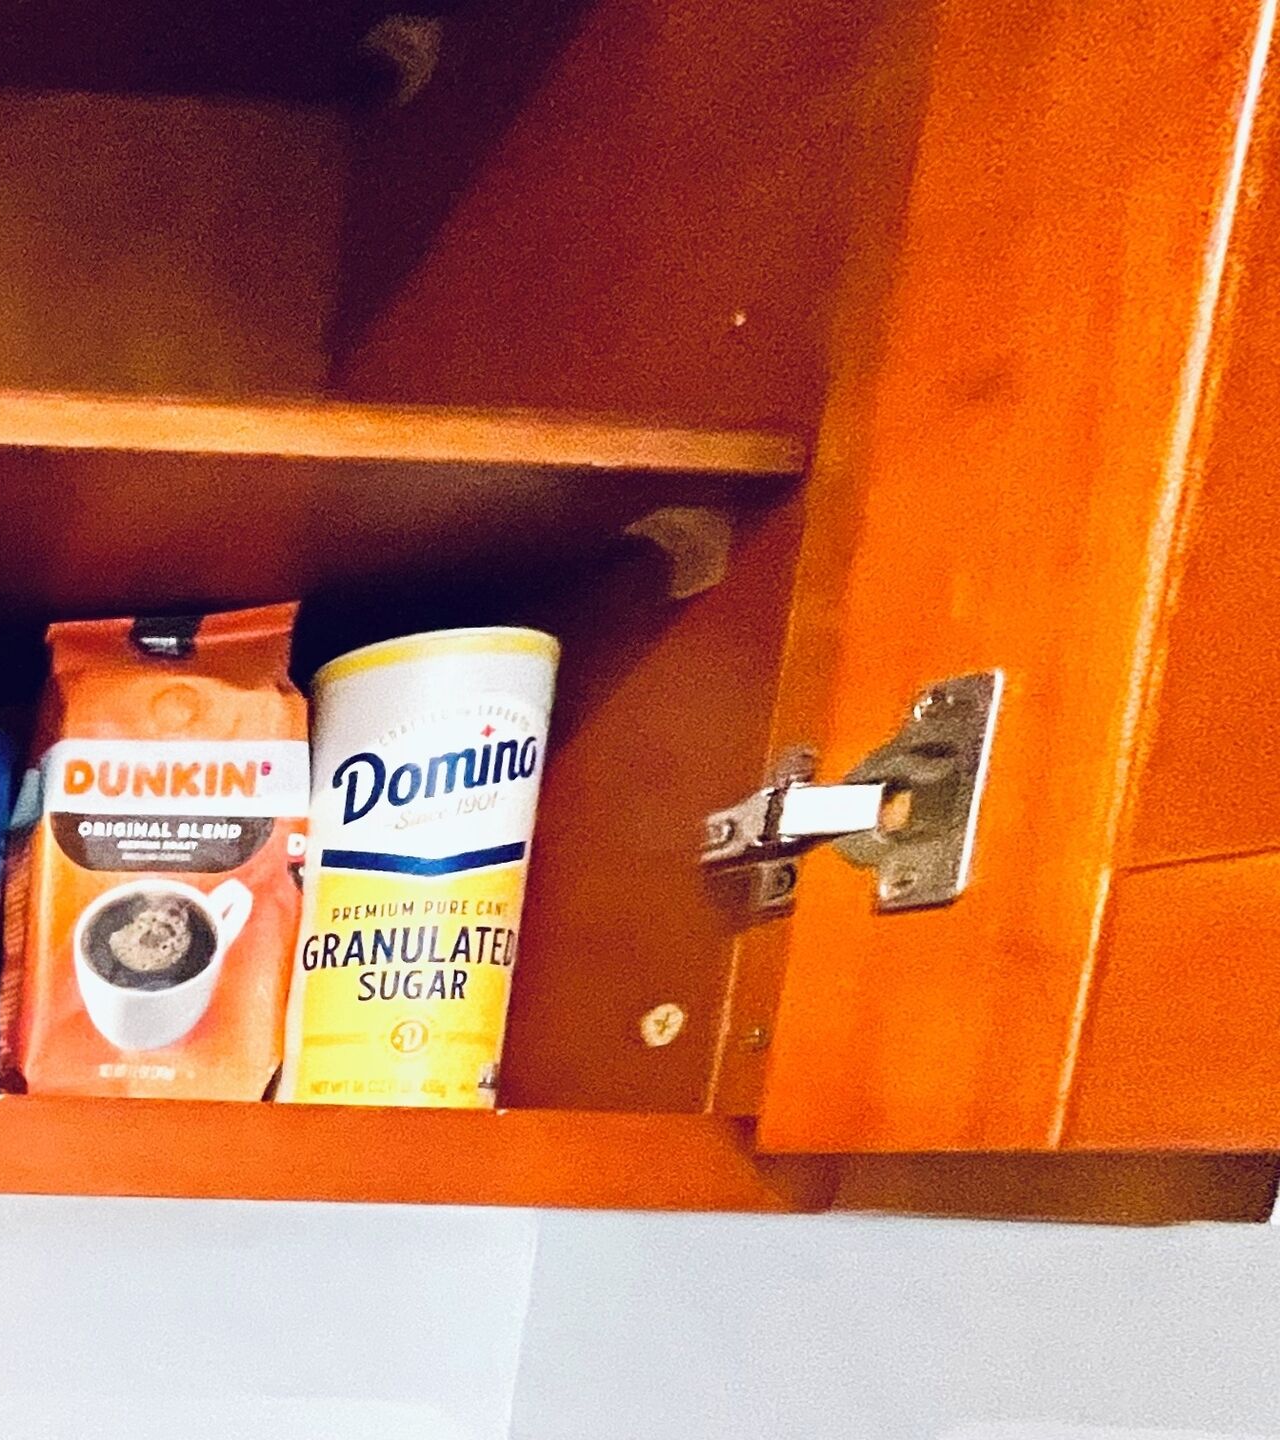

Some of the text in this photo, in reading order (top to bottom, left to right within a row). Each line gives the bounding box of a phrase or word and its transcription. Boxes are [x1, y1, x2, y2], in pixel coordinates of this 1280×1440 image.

[332, 736, 537, 826] Domino
[456, 791, 498, 816] 1901
[77, 821, 241, 839] ORIGINAL BLEND
[332, 901, 415, 922] PREMIUM
[424, 900, 468, 915] PURE
[302, 926, 517, 971] GRANULATED
[358, 969, 468, 1002] SUGAR
